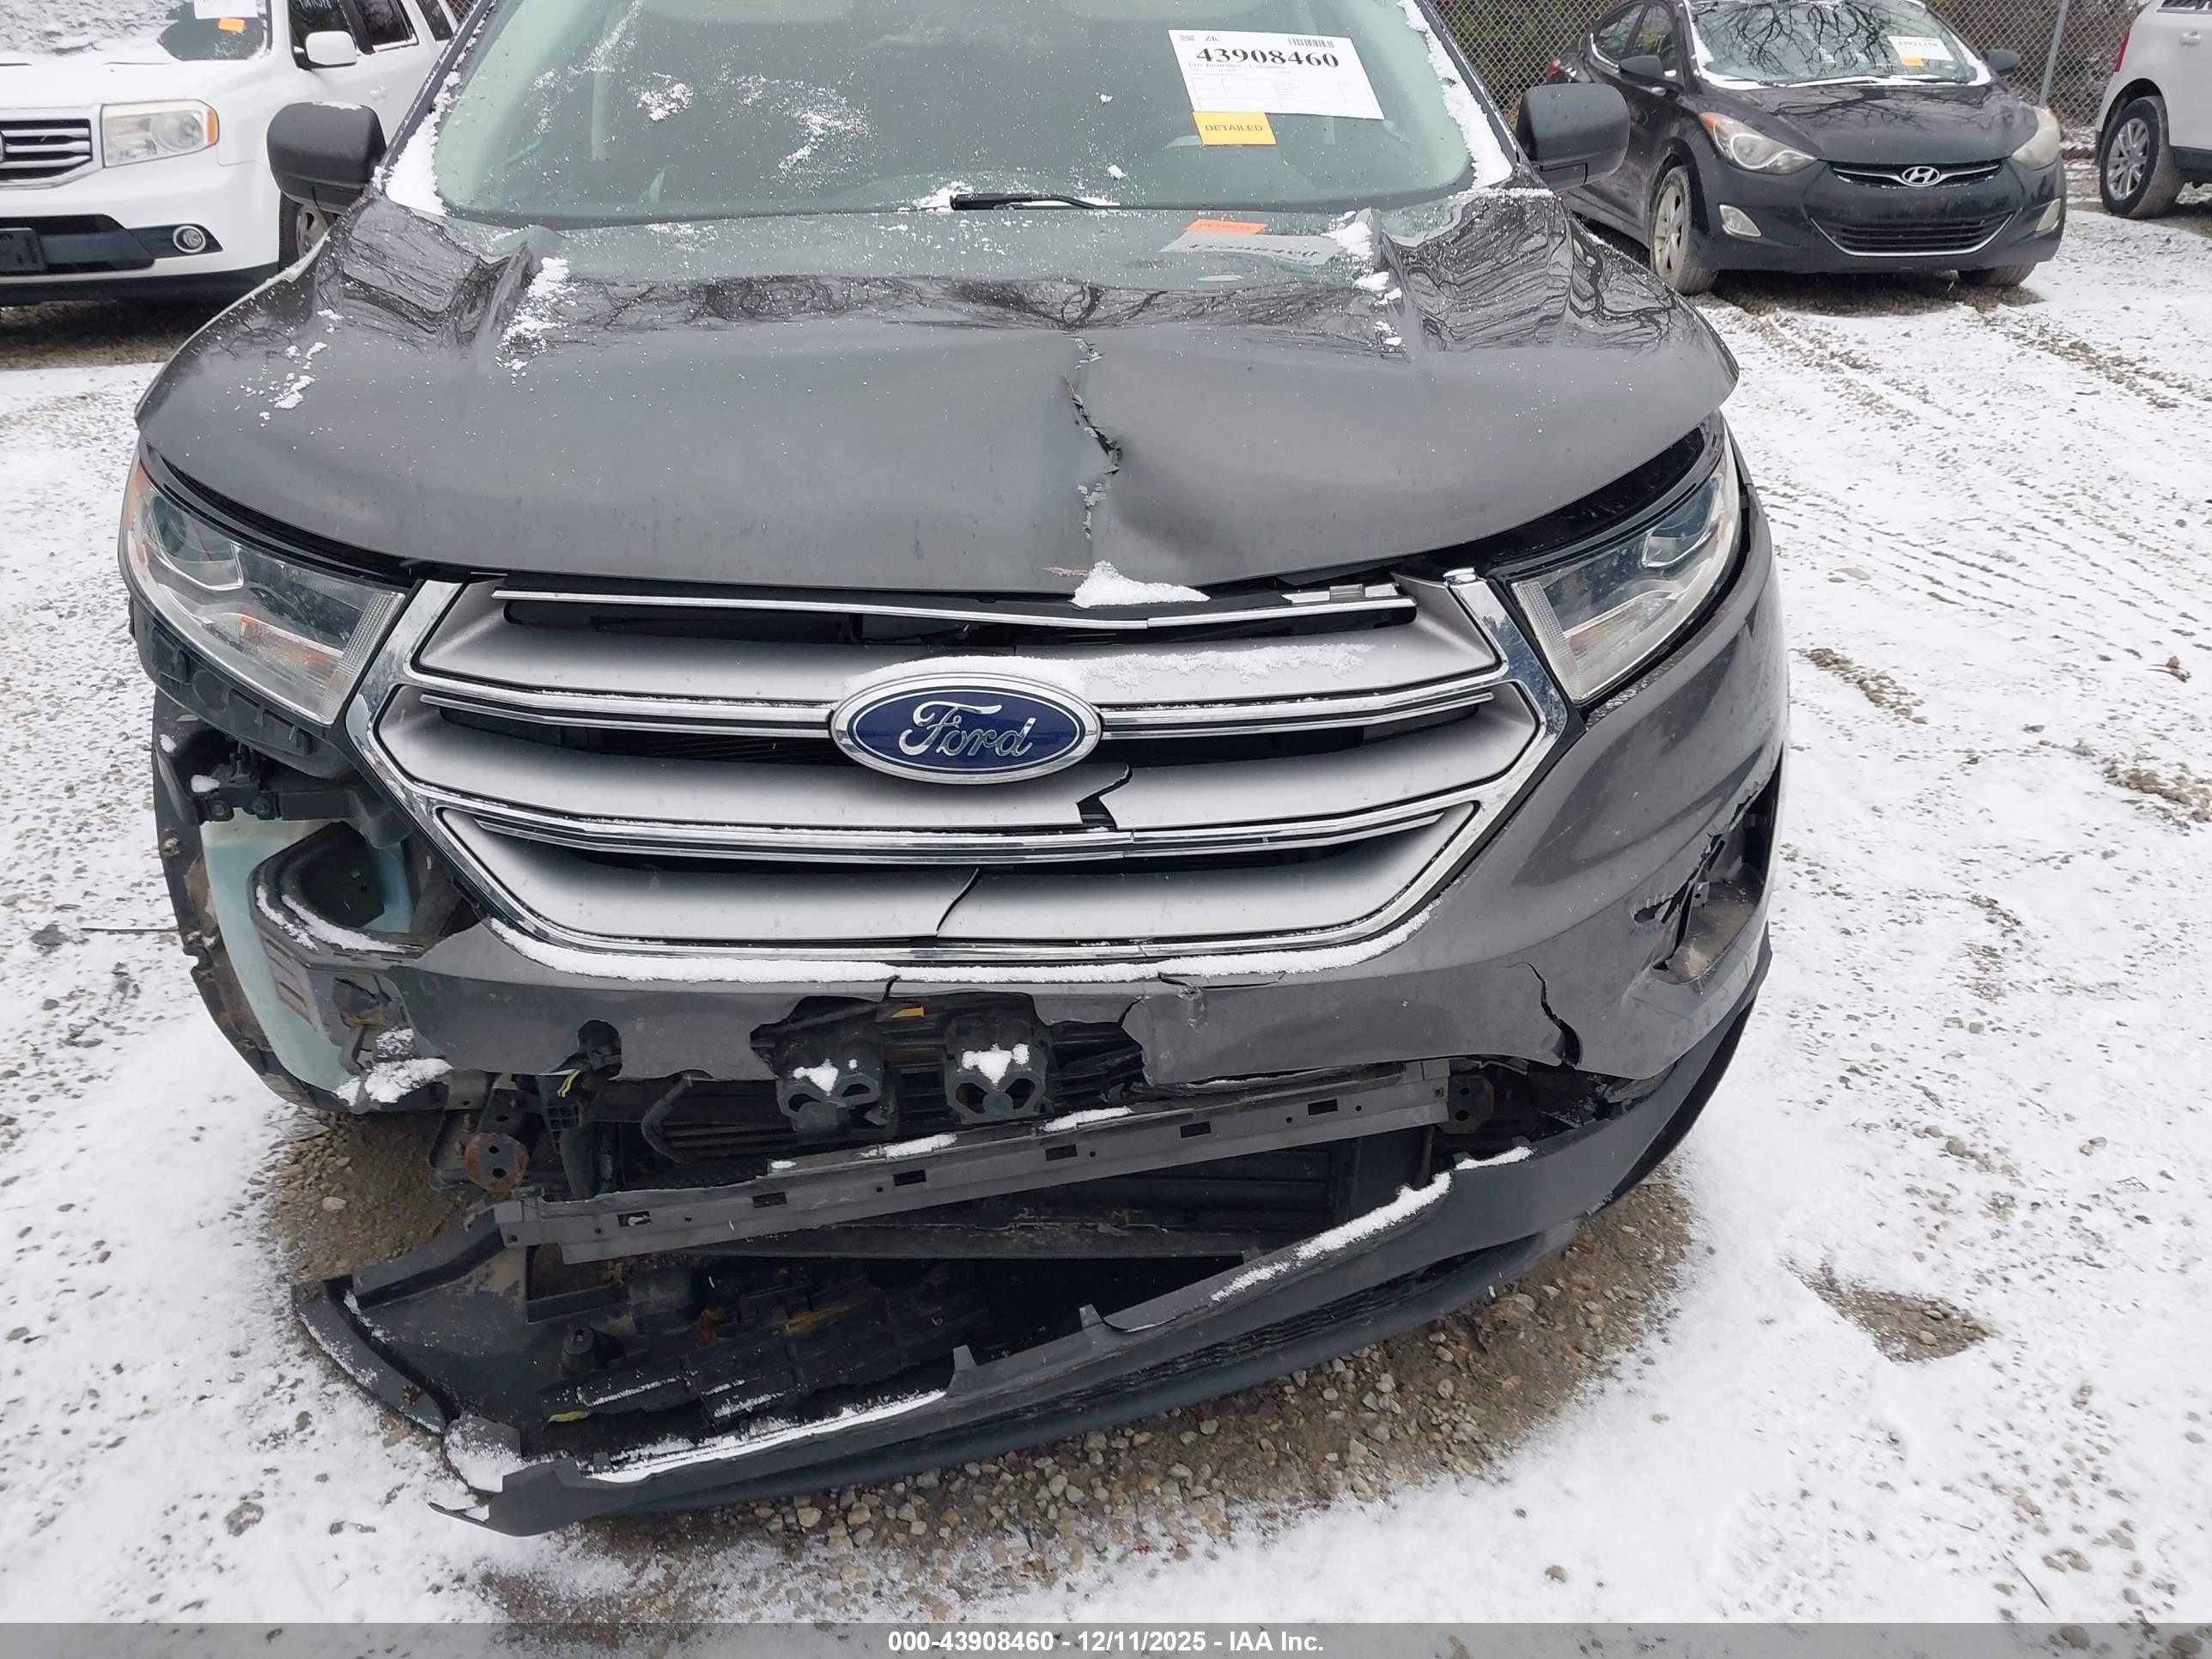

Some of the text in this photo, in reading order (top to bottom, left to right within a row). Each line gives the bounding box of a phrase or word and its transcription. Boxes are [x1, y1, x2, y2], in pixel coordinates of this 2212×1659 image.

[1196, 48, 1339, 68] 43908460
[1205, 124, 1263, 132] DETAILED
[898, 700, 1037, 757] Ford
